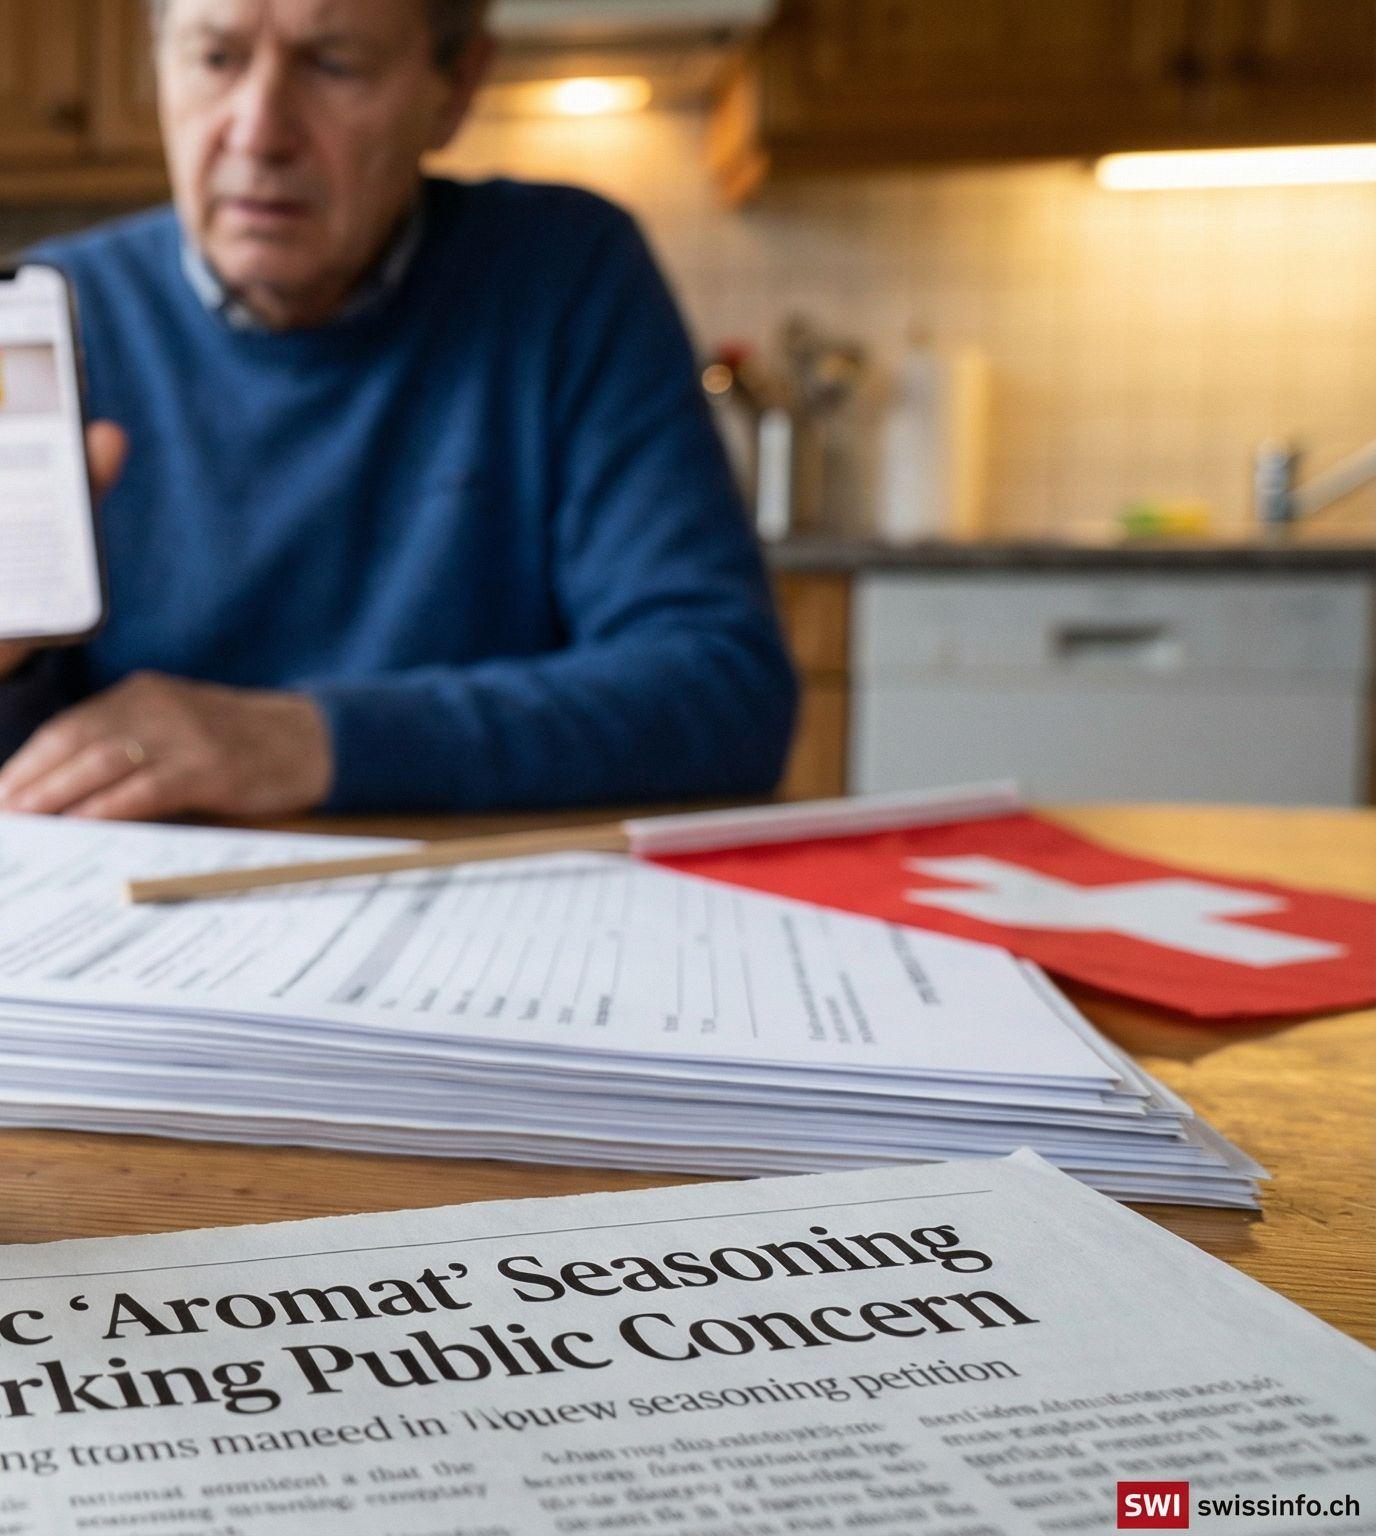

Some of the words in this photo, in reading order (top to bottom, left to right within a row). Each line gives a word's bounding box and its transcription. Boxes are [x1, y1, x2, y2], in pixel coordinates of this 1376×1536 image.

[68, 1261, 474, 1341] ‘Aromat’
[496, 1223, 995, 1304] Seasoning
[280, 1322, 615, 1396] Public
[617, 1289, 1042, 1363] Concern
[69, 1437, 201, 1467] troms
[210, 1414, 394, 1456] maneed
[400, 1413, 450, 1439] in
[626, 1377, 853, 1417] seasoning
[849, 1358, 1023, 1400] petition
